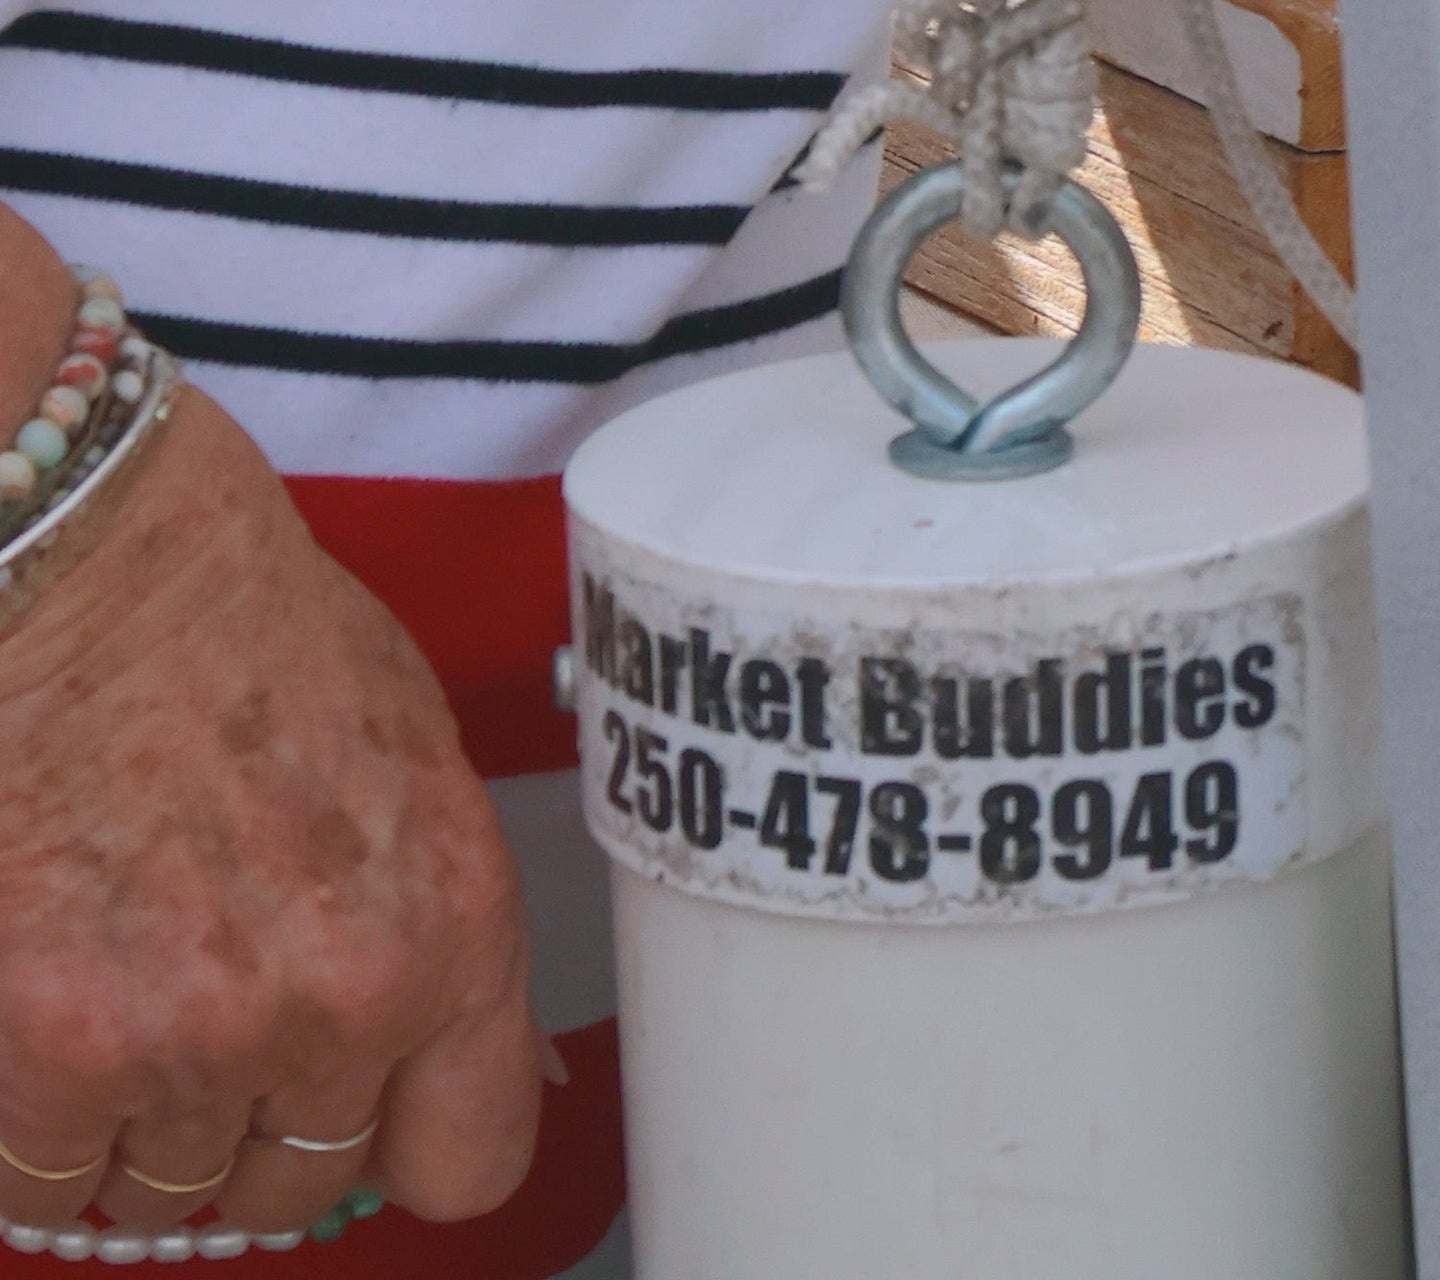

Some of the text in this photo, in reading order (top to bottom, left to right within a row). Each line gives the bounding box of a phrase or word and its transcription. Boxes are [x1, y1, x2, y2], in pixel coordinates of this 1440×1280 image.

[584, 570, 1279, 760] Market Buddies
[605, 708, 1241, 883] 250-478-8949
